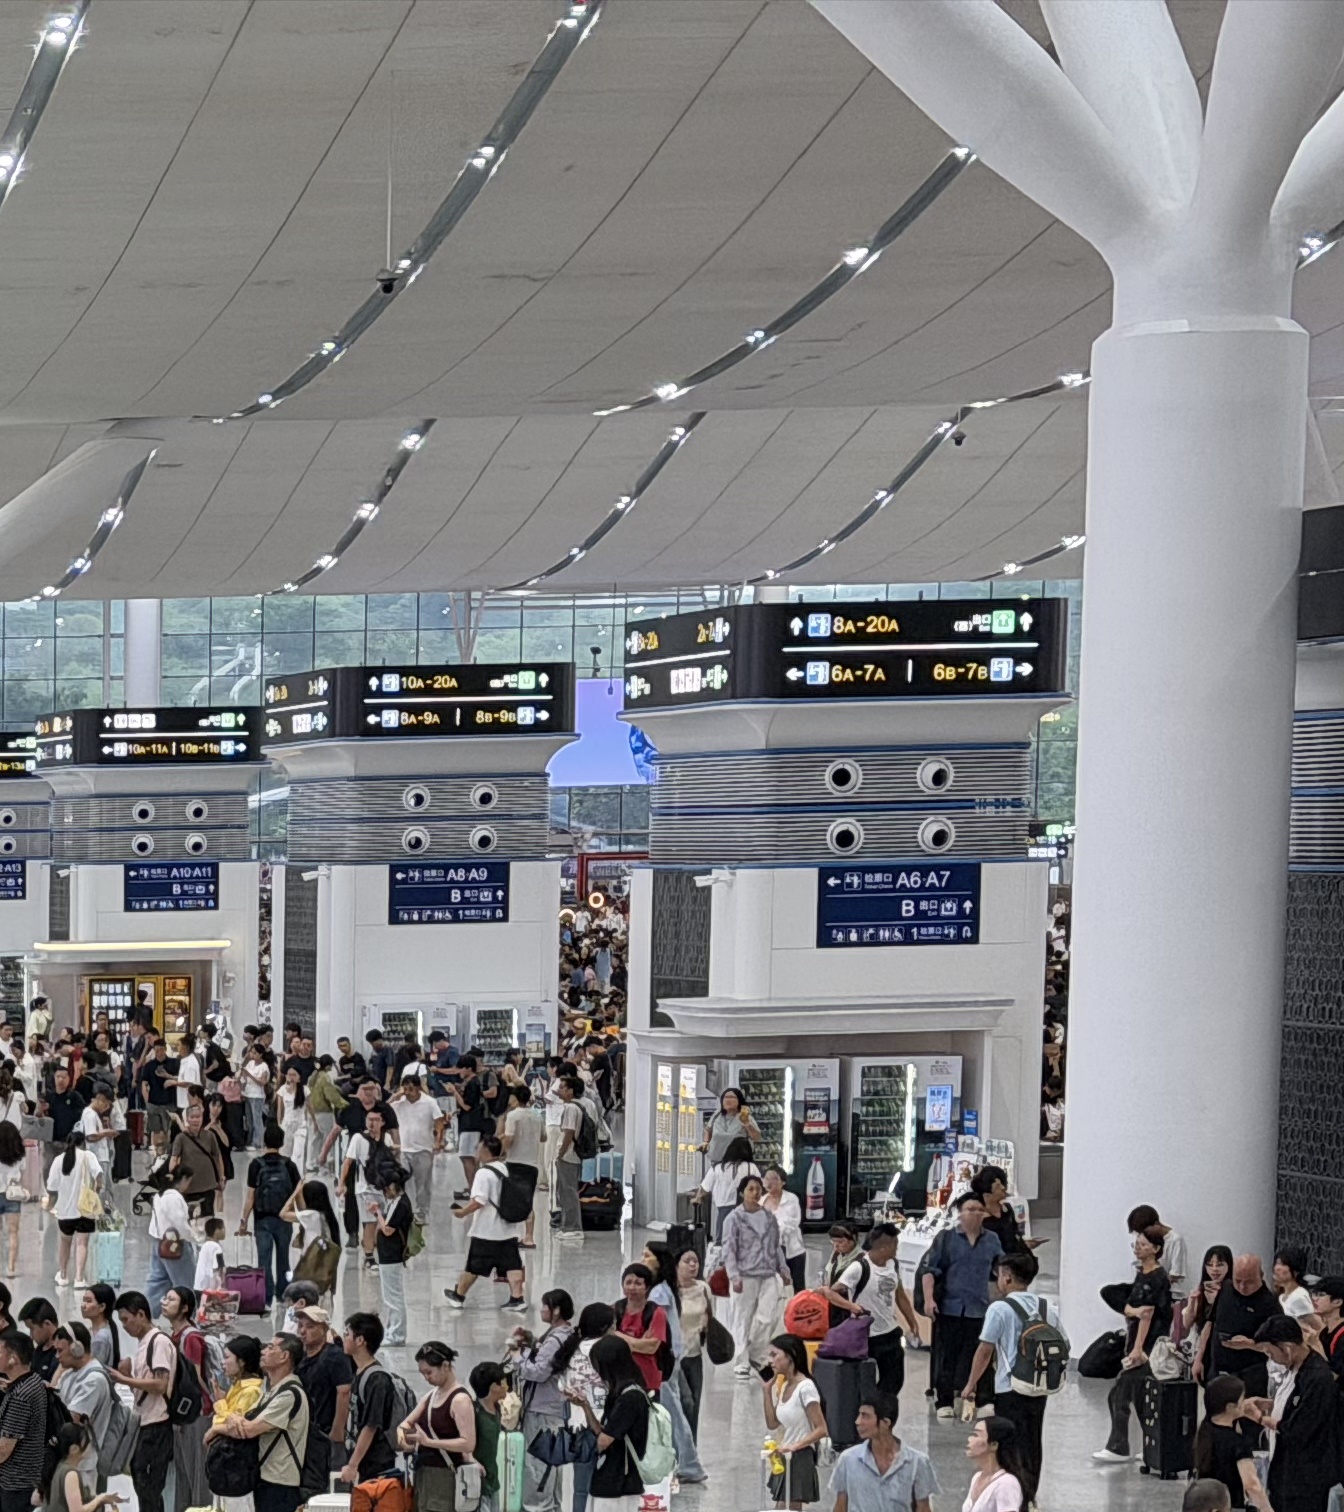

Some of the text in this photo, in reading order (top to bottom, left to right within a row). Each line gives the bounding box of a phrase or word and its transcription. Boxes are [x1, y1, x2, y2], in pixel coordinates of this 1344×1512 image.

[834, 617, 899, 633] 8A-20A
[973, 614, 991, 625] 出口
[831, 665, 988, 683] 6A-7A 6B-7B
[401, 675, 458, 689] 10A-20A
[400, 711, 516, 724] 8A-9A 8B-9B
[128, 743, 219, 754] 10A-11A 10B-11B
[864, 873, 893, 883] 检票口
[173, 884, 181, 894] B
[451, 889, 461, 902] B
[902, 900, 938, 917] B 出口
[911, 928, 918, 940] 1
